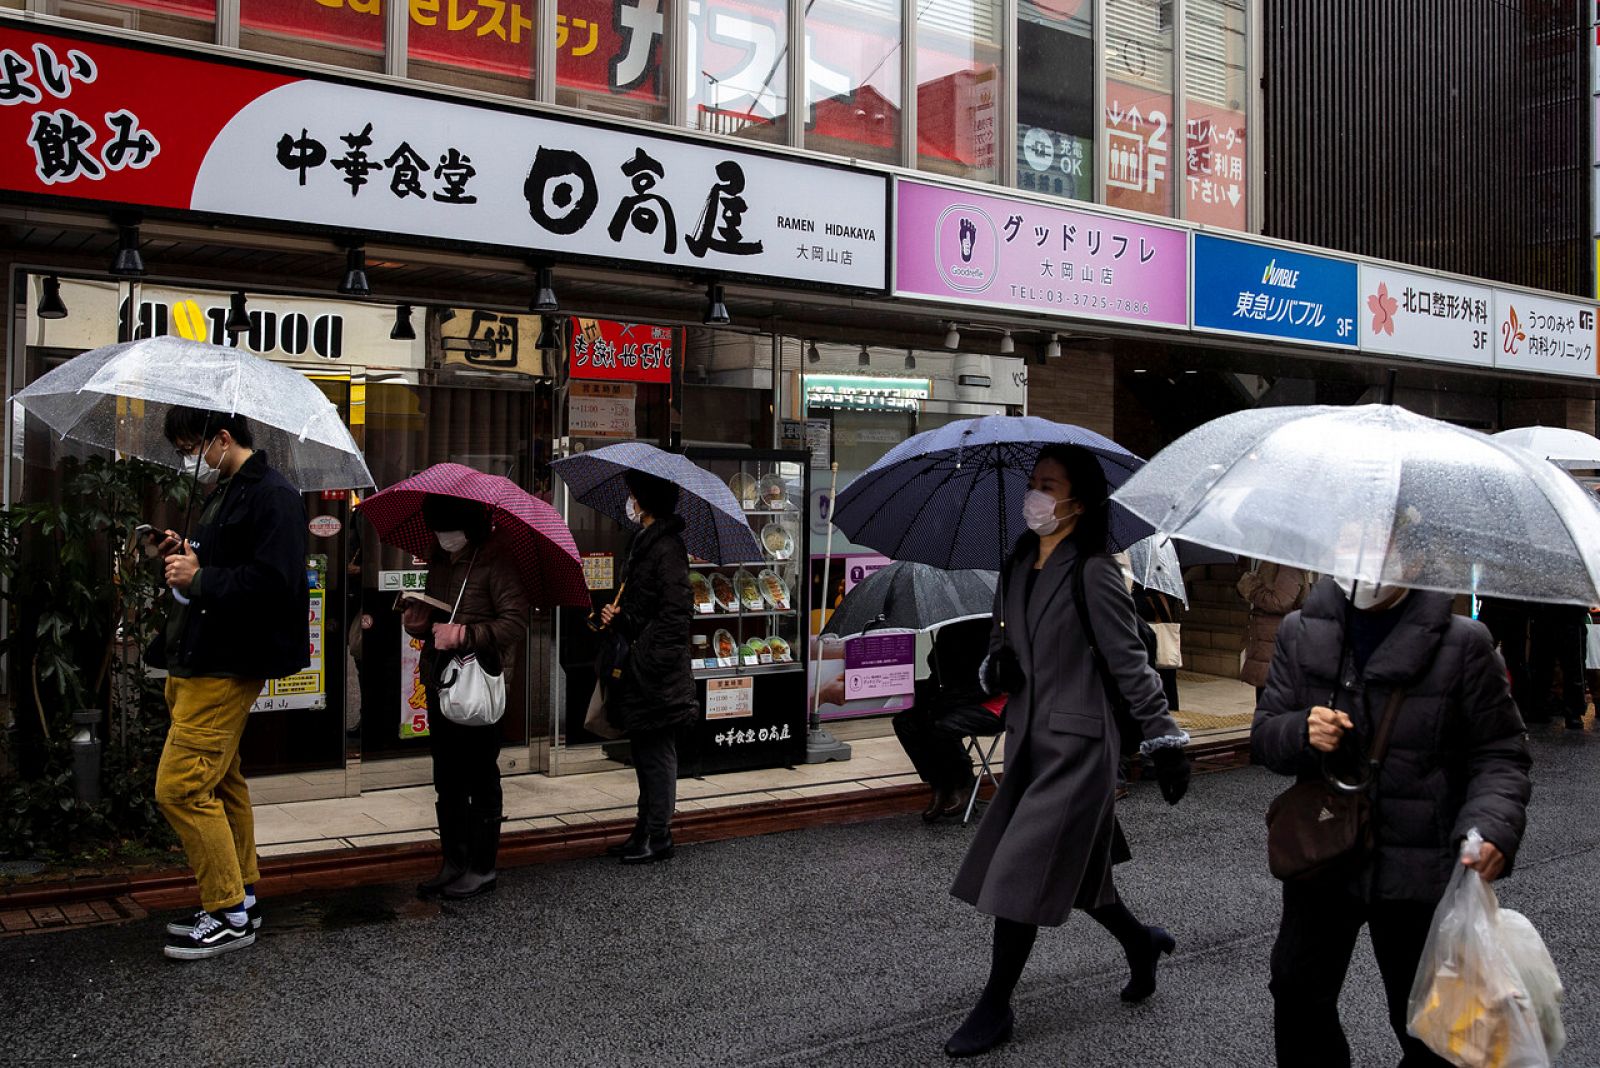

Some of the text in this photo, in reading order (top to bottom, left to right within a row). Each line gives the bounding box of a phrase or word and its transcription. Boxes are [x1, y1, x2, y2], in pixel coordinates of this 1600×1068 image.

[31, 110, 159, 184] 飲み
[1186, 119, 1242, 150] エレベーター
[1060, 139, 1084, 158] 充電
[1060, 157, 1083, 177] OK
[1186, 146, 1242, 181] をご利用
[276, 122, 764, 258] 中華食堂 日高屋
[1187, 177, 1226, 204] 下さい
[777, 215, 876, 242] RAMEN HIDAKAYA
[1003, 214, 1156, 264] グッドリフレ
[796, 244, 853, 265] 大岡山店
[1040, 259, 1113, 286] 大岡山店
[1233, 291, 1326, 328] 東急リバブル
[1402, 286, 1488, 325] 北口整形外科
[1336, 318, 1353, 337] 3F
[1529, 310, 1575, 334] うつのみや
[1472, 330, 1488, 350] 3F
[1529, 335, 1592, 360] 内科クリニック
[714, 727, 756, 747] 中華食堂
